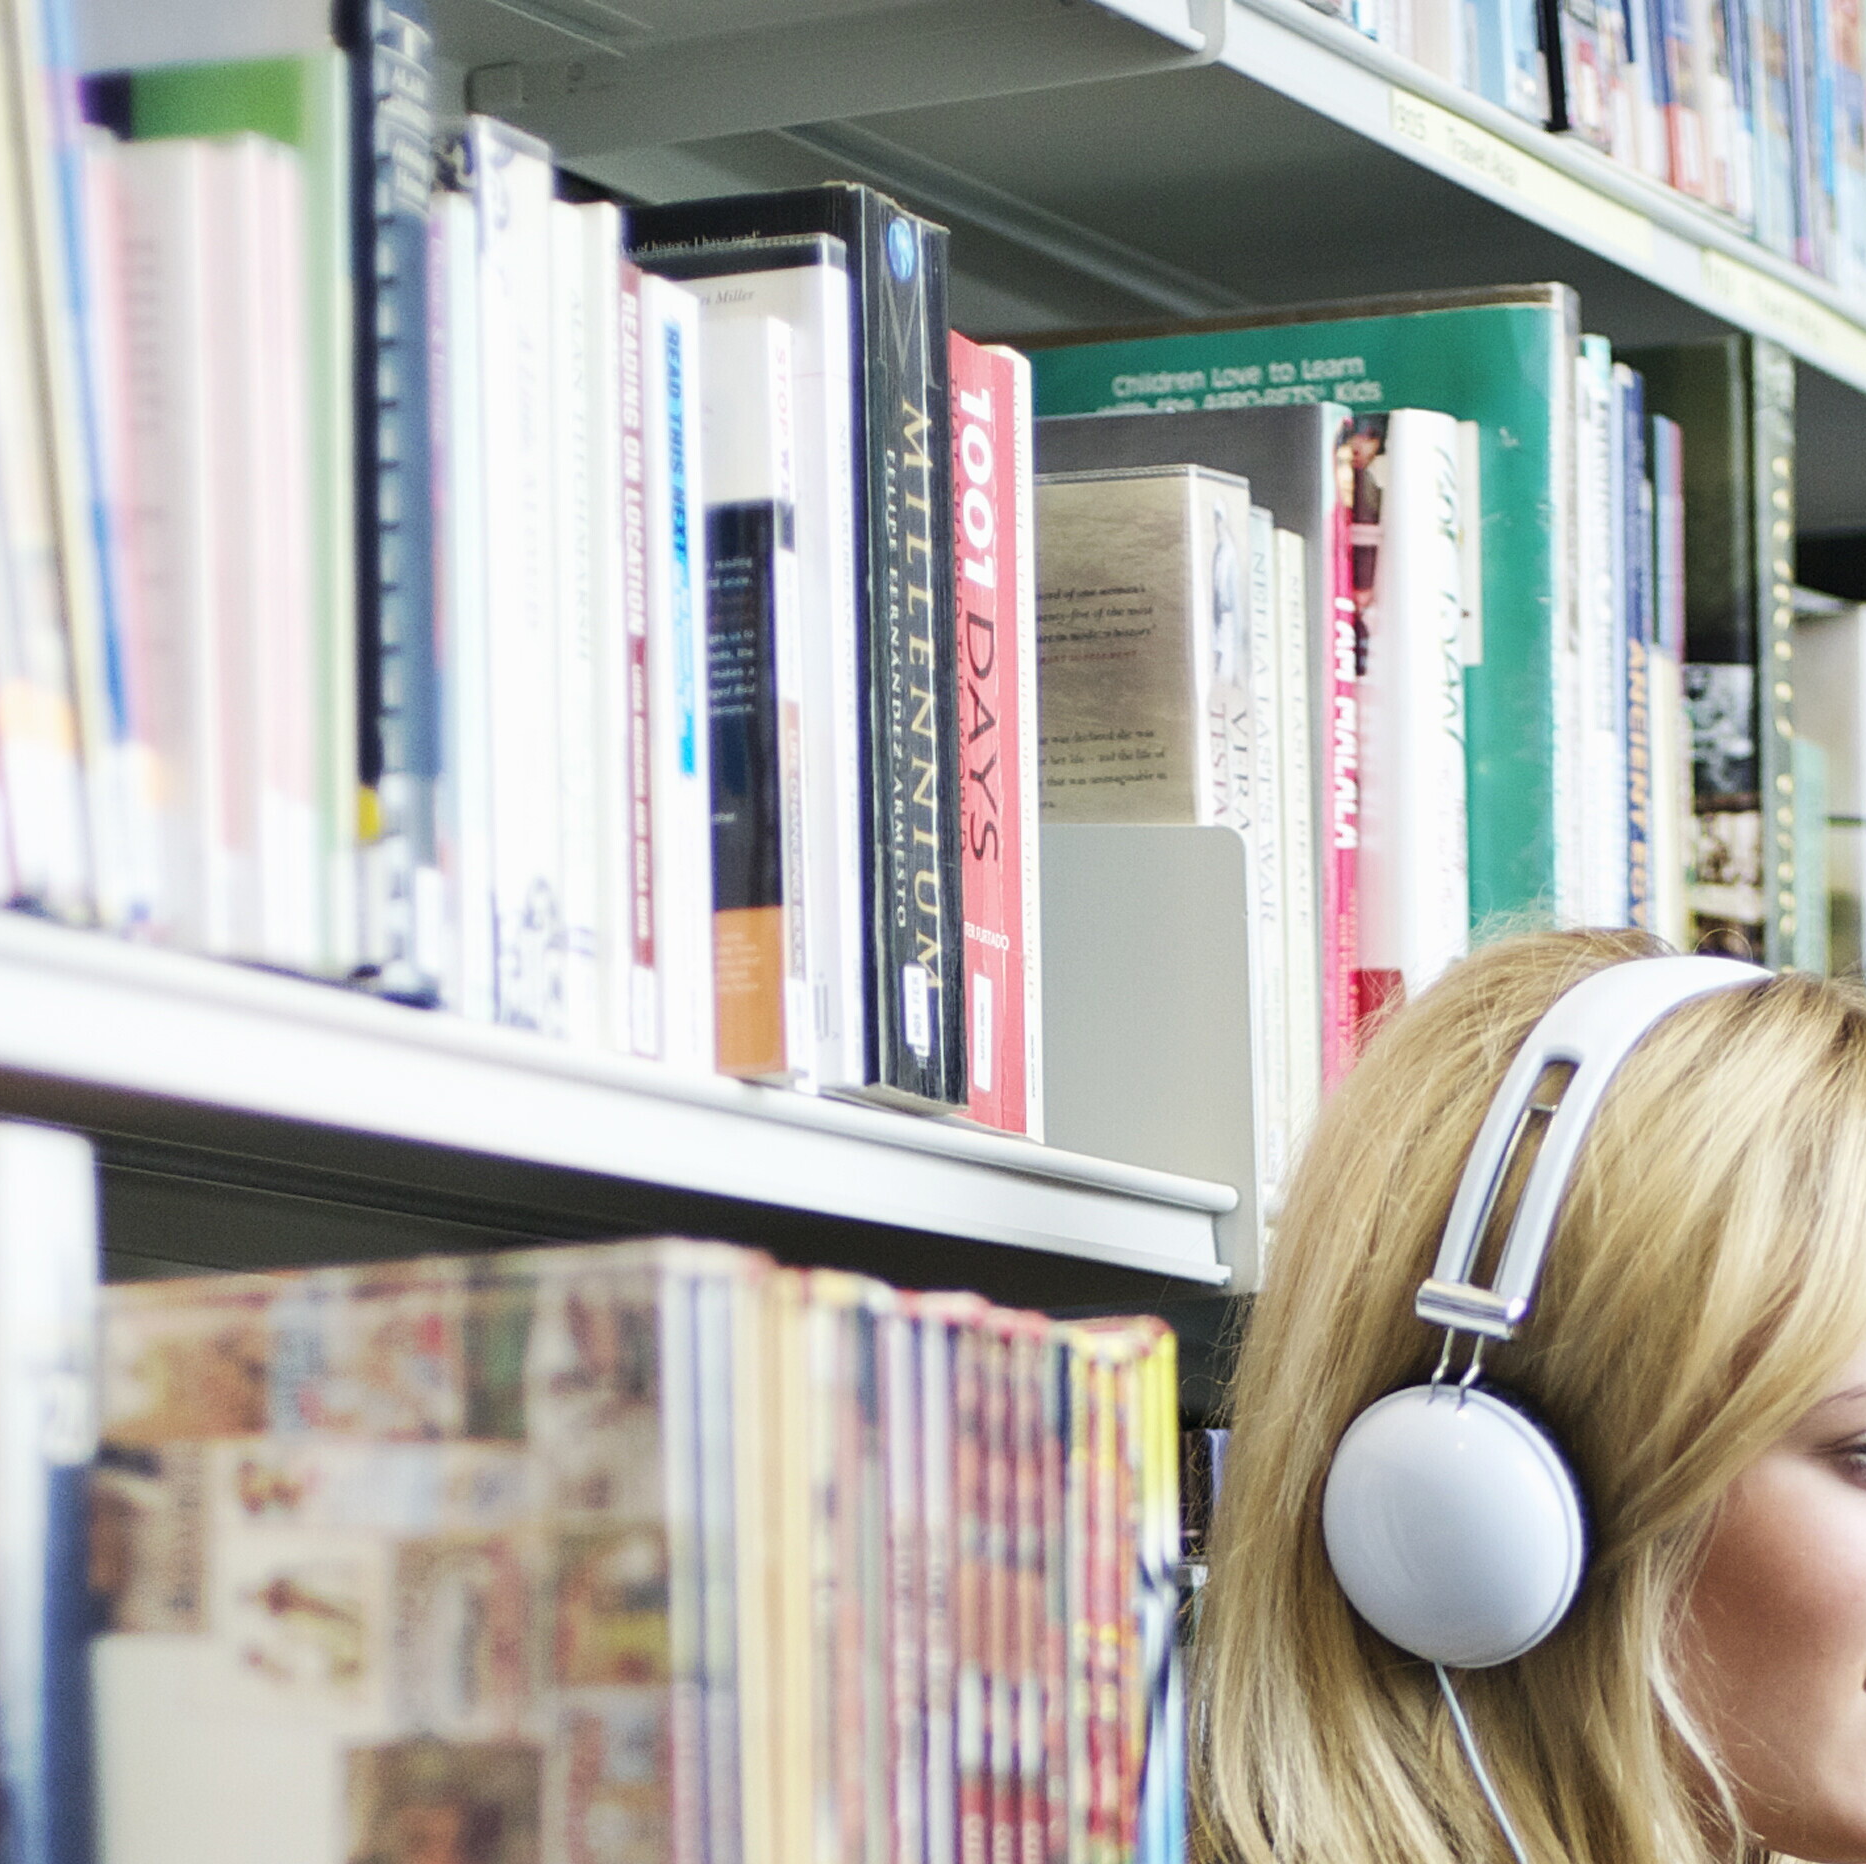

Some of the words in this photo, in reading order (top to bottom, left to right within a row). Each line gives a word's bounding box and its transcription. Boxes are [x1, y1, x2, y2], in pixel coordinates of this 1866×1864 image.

[620, 291, 643, 429] READING
[665, 324, 683, 400] READ
[775, 347, 790, 437] STOP
[1111, 370, 1207, 398] Children
[1209, 366, 1263, 389] Love
[1267, 361, 1296, 383] to
[1300, 356, 1367, 380] Learn
[1333, 380, 1384, 403] Kids
[623, 434, 644, 483] ON
[666, 412, 687, 476] THIS
[837, 421, 849, 478] NEW
[959, 386, 996, 590] 1001
[1012, 380, 1024, 530] GOMBRICH
[669, 484, 690, 559] NEXT
[886, 448, 898, 553] FELIPE
[624, 487, 646, 637] LOCATION
[839, 485, 853, 630] CARIBBEAN
[1333, 596, 1357, 613] I
[901, 395, 944, 990] MILLENNIUM
[1333, 619, 1357, 684] AM
[965, 609, 1000, 864] DAYS
[1209, 702, 1228, 829] TESTA
[1230, 708, 1251, 833] VERA
[1333, 696, 1359, 850] MALALA
[1259, 840, 1277, 923] WAR
